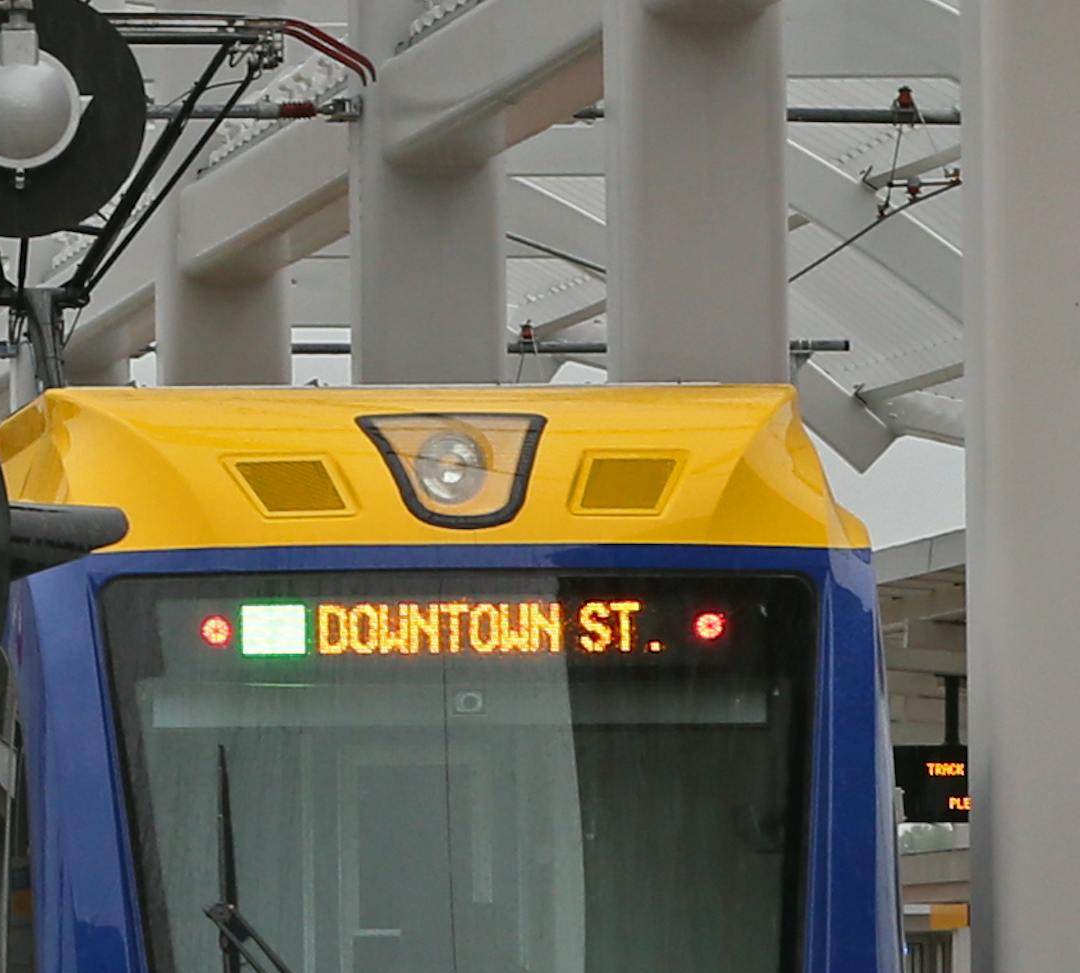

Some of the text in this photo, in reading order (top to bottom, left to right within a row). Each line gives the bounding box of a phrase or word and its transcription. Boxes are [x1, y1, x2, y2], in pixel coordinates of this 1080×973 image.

[319, 600, 663, 656] DOWNTOWN ST.
[925, 762, 965, 777] TRACK
